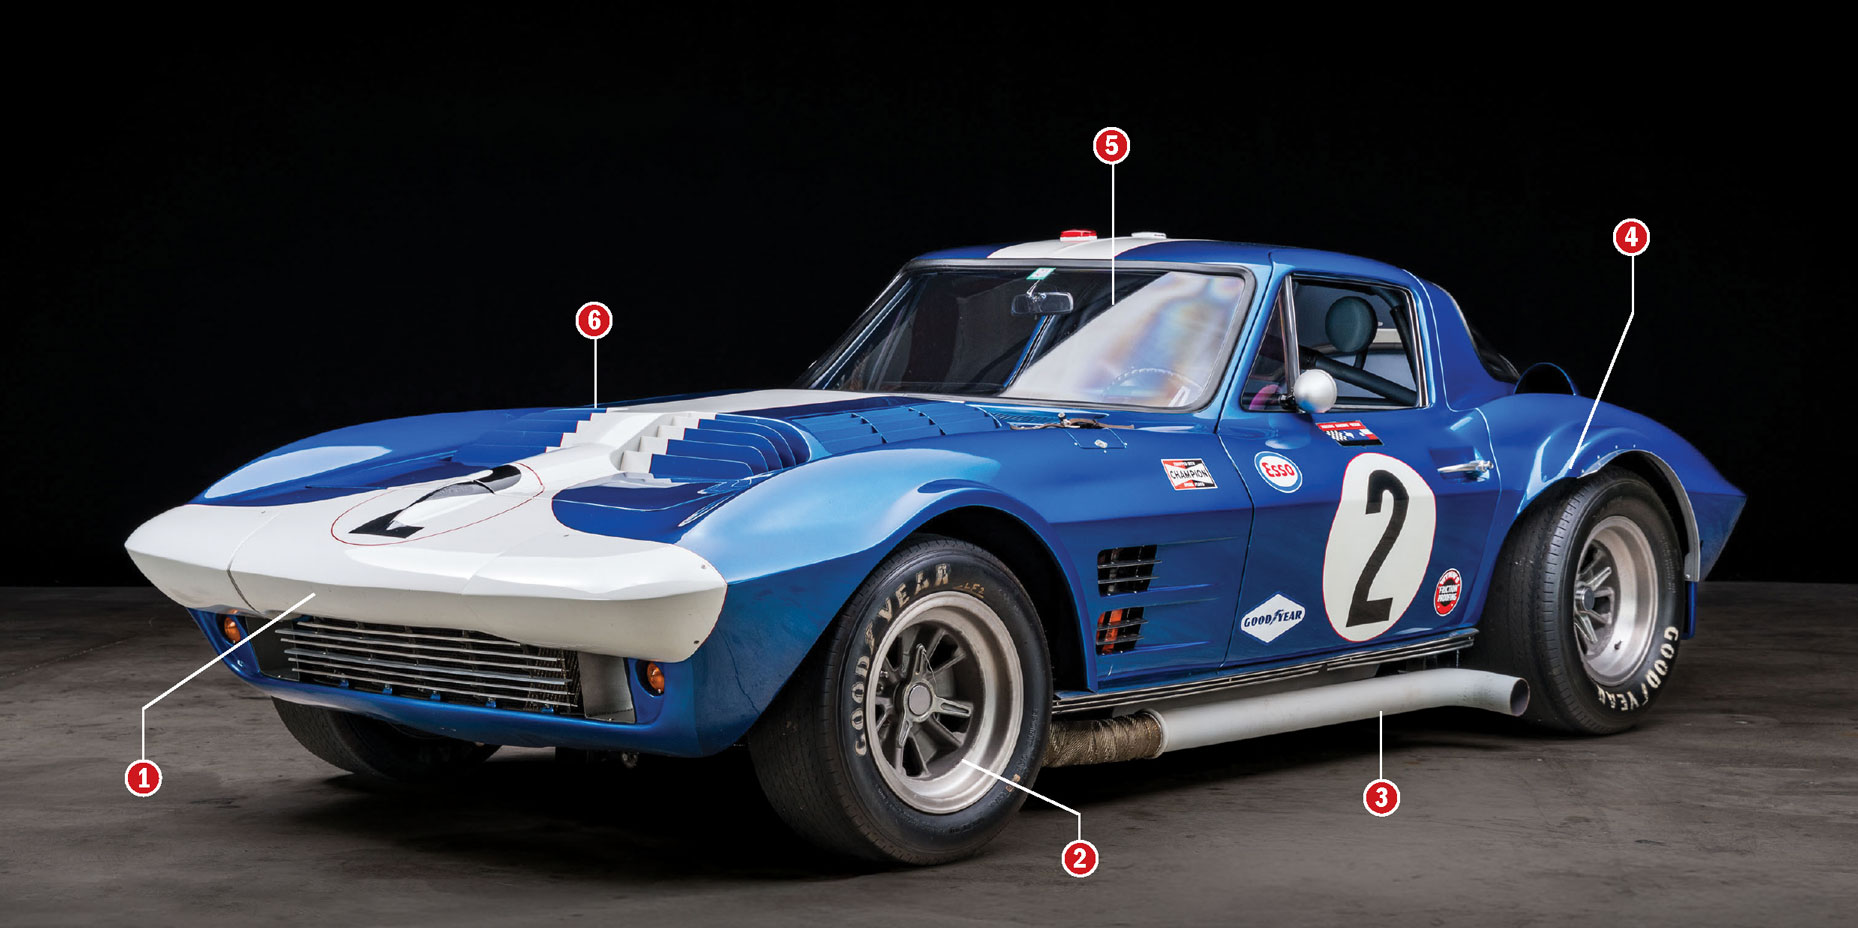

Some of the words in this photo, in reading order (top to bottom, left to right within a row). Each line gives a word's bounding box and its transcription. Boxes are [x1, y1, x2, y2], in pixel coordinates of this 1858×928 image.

[348, 464, 521, 538] 2
[1169, 469, 1208, 480] CHAMPION
[1346, 469, 1410, 628] 2
